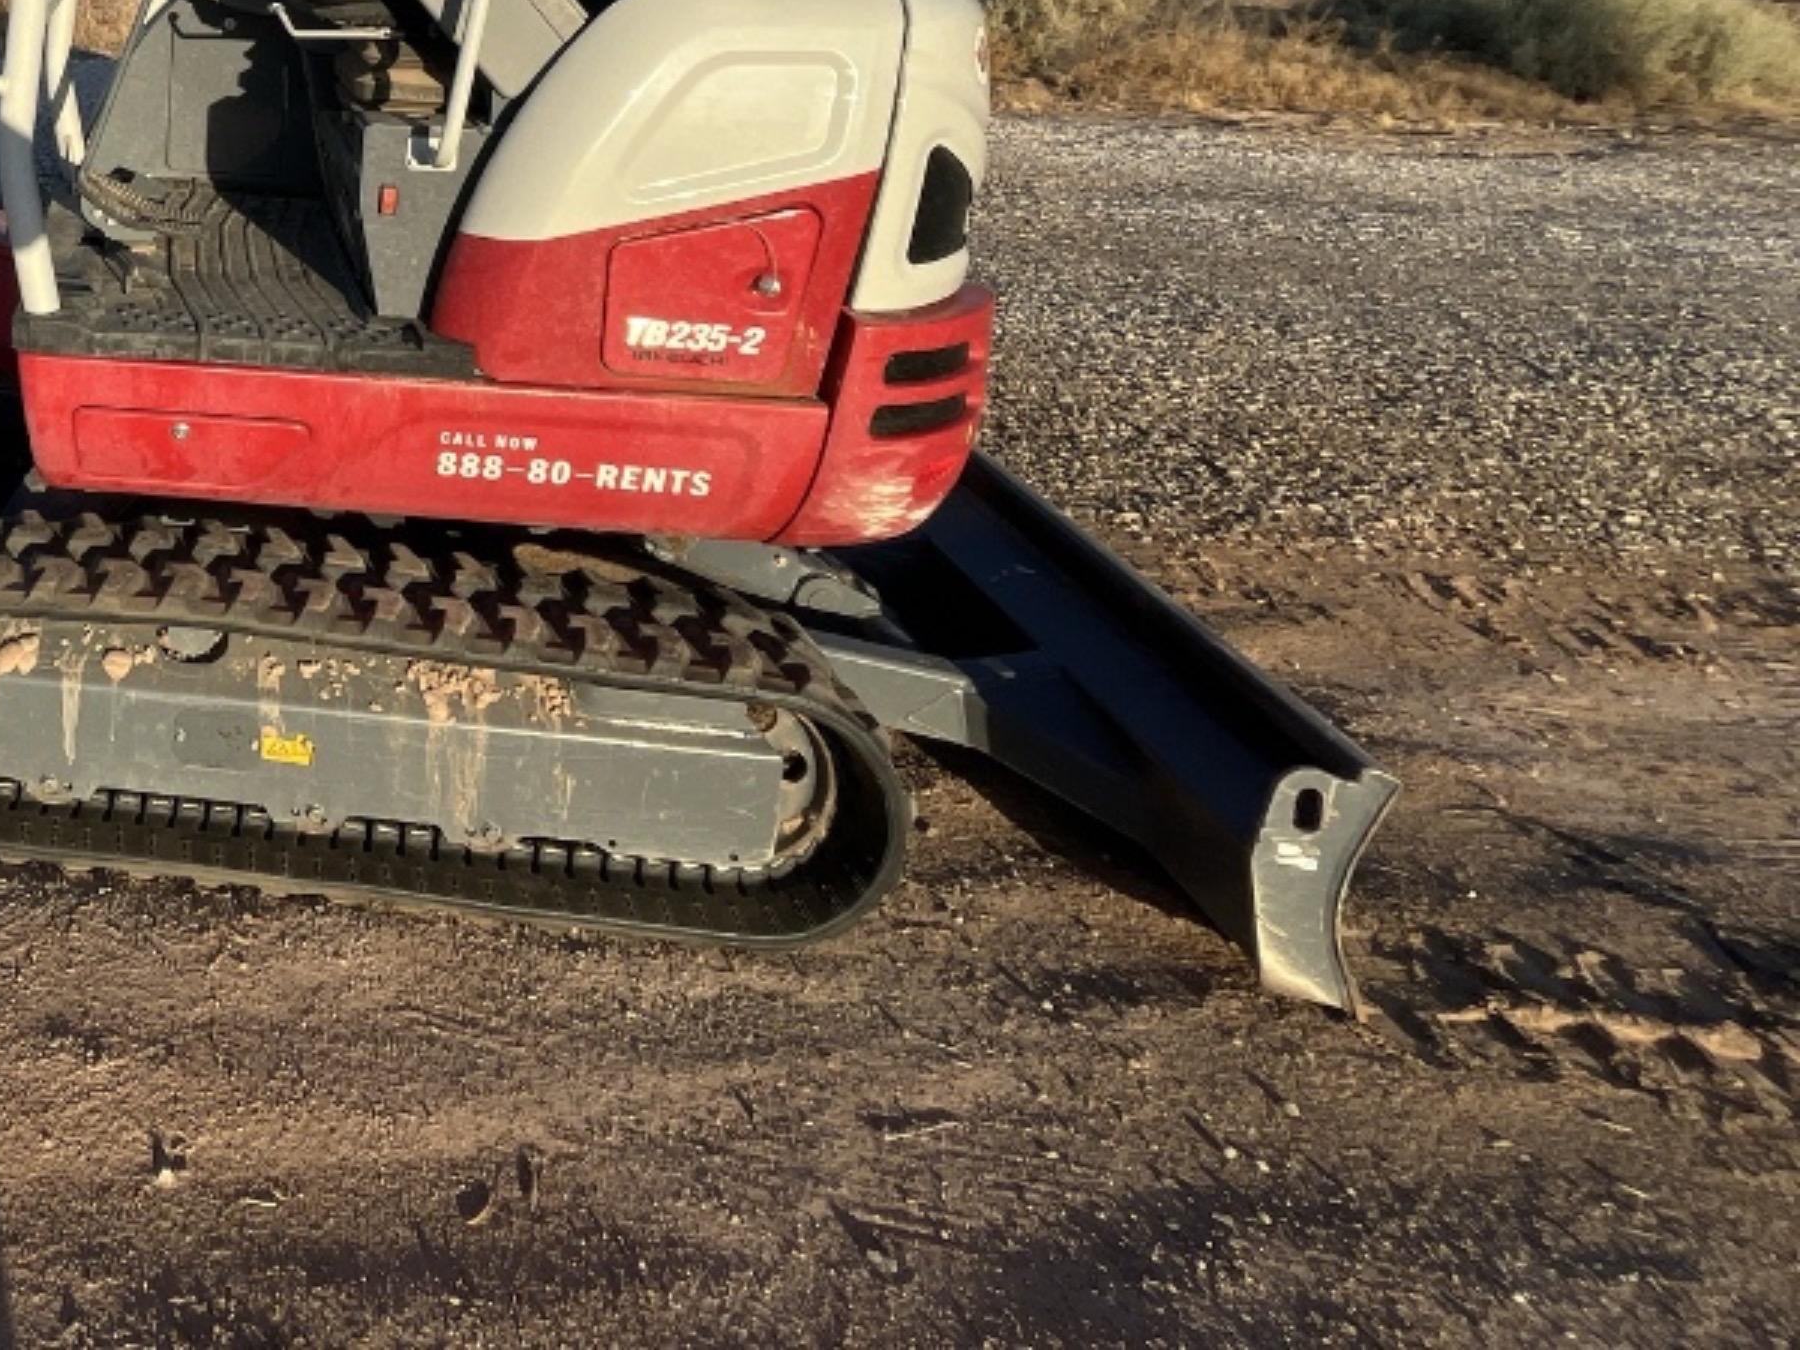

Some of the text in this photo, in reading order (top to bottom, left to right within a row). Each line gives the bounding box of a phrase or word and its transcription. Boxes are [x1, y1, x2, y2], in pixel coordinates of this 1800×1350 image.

[625, 317, 766, 355] TB235-2
[440, 431, 539, 451] CALL NOW
[437, 452, 713, 497] 888-80-RENTS
